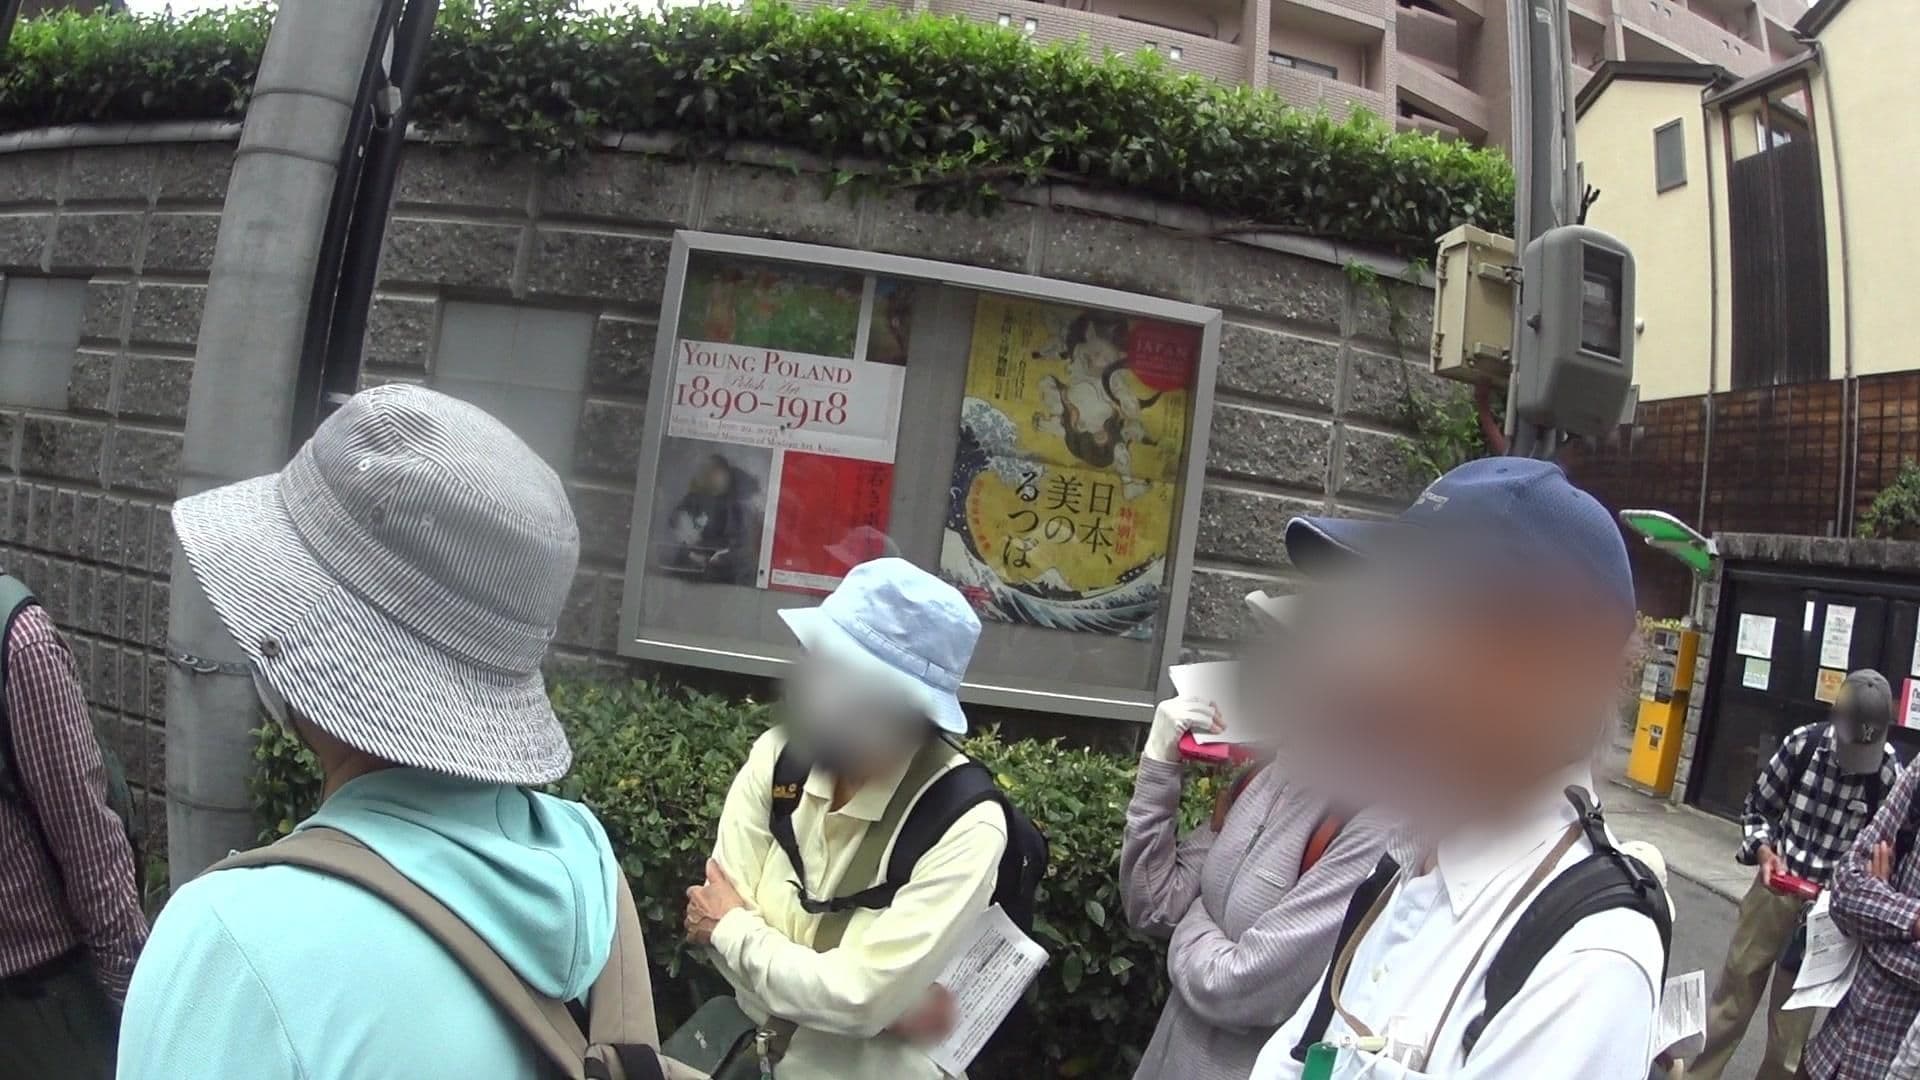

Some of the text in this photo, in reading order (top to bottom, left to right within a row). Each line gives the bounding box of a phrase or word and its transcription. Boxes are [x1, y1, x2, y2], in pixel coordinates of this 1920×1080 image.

[684, 342, 852, 385] YOUNG POLAND
[1003, 471, 1040, 568] るつぼ
[1045, 475, 1083, 544] 美の
